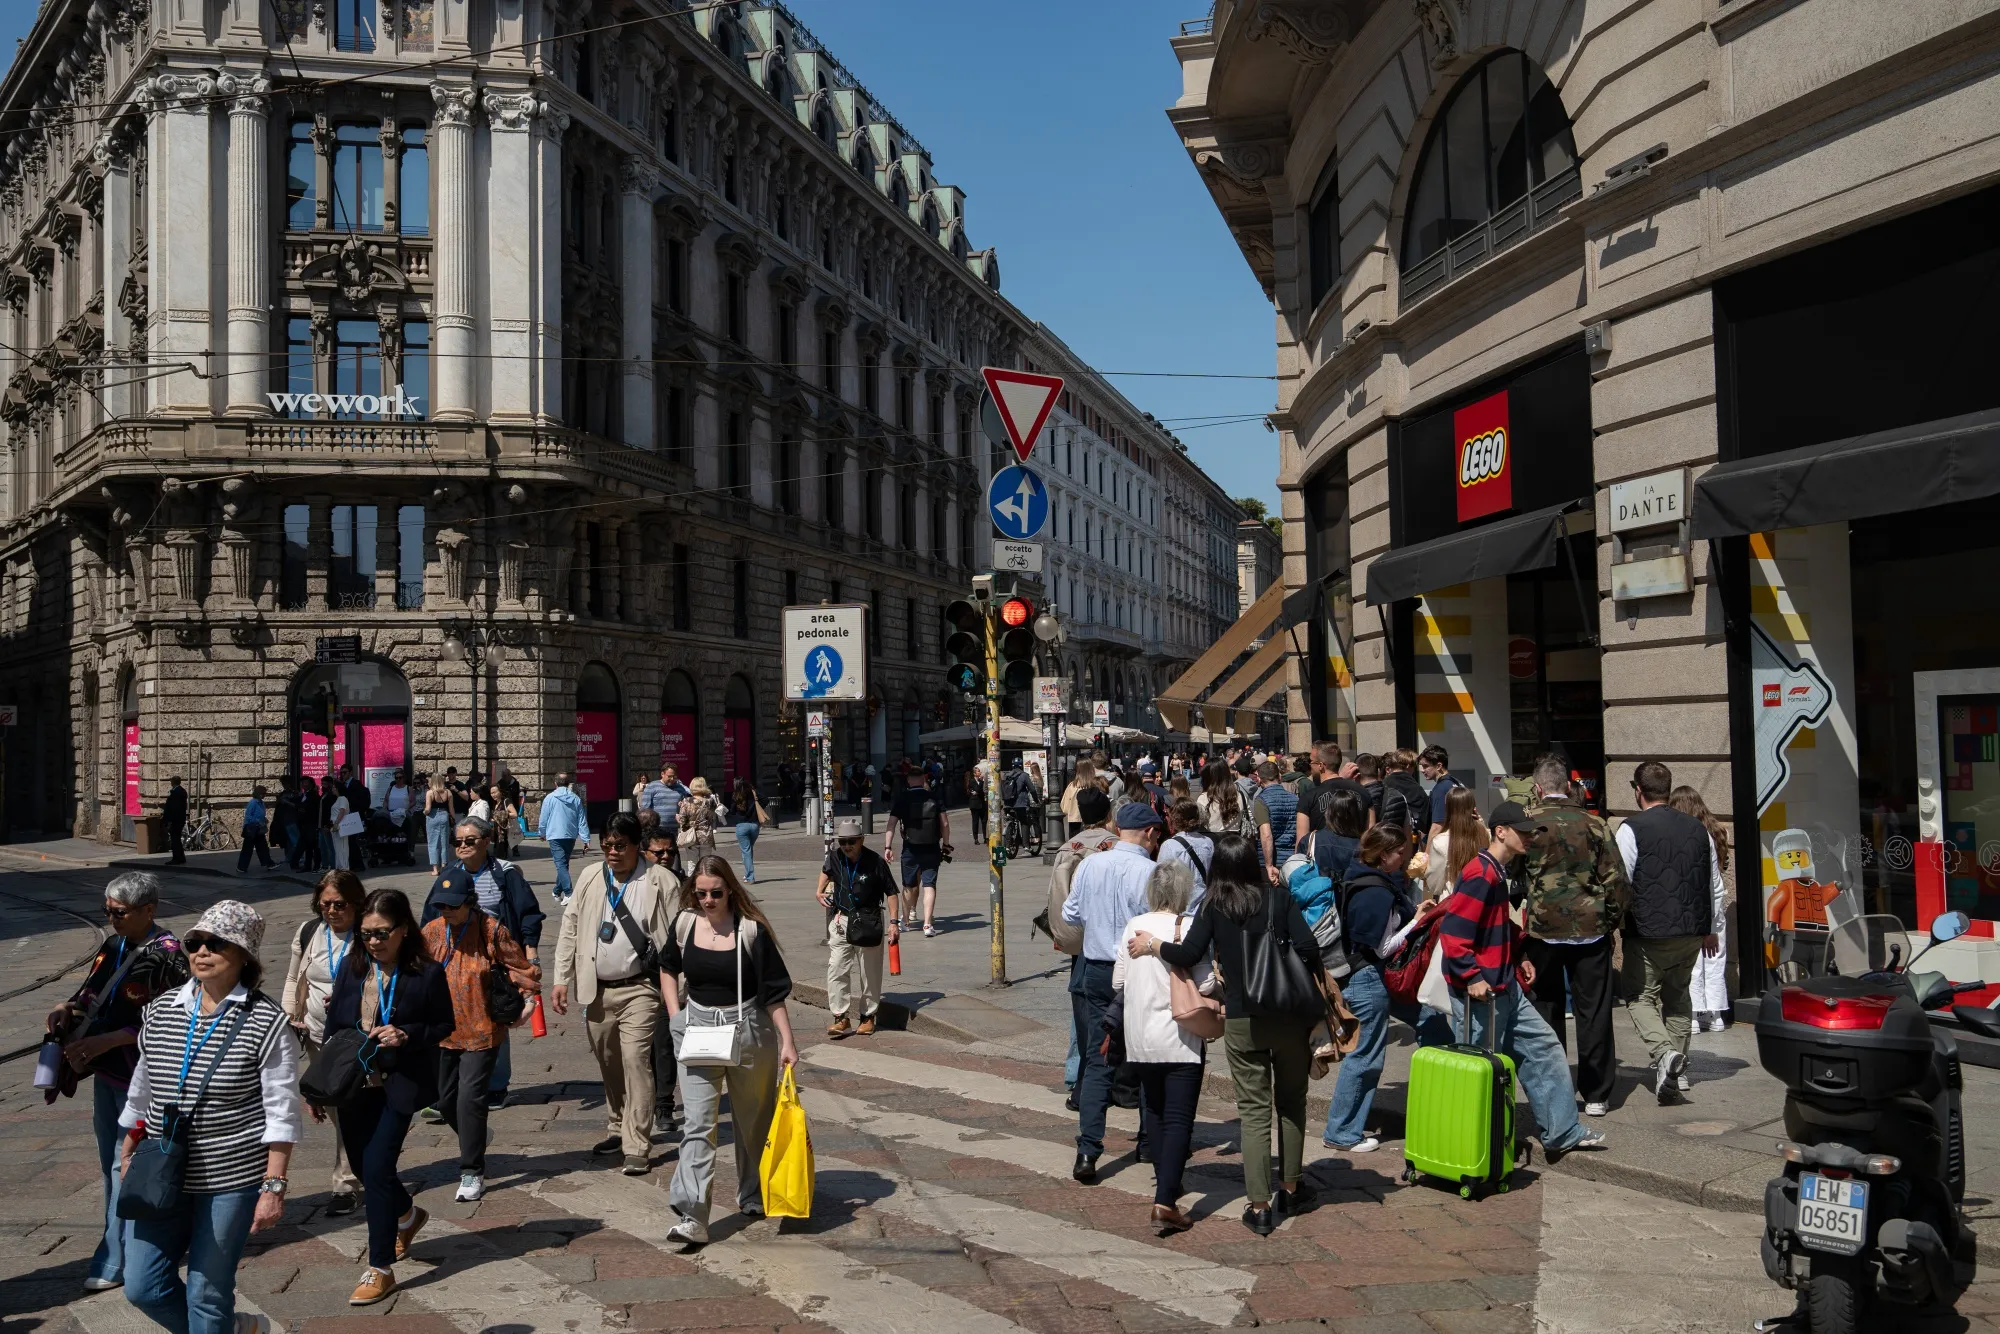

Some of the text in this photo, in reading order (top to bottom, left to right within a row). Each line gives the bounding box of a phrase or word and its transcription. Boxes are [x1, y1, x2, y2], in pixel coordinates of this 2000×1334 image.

[265, 383, 422, 415] wework
[1461, 429, 1505, 485] LEGO
[1619, 494, 1676, 521] DANTE
[1004, 544, 1033, 553] eccetto
[811, 614, 835, 623] area
[797, 627, 849, 640] pedonale
[1764, 690, 1780, 701] LEGO
[580, 731, 603, 744] energia
[1816, 1179, 1840, 1203] EW
[1802, 1205, 1858, 1236] 05851
